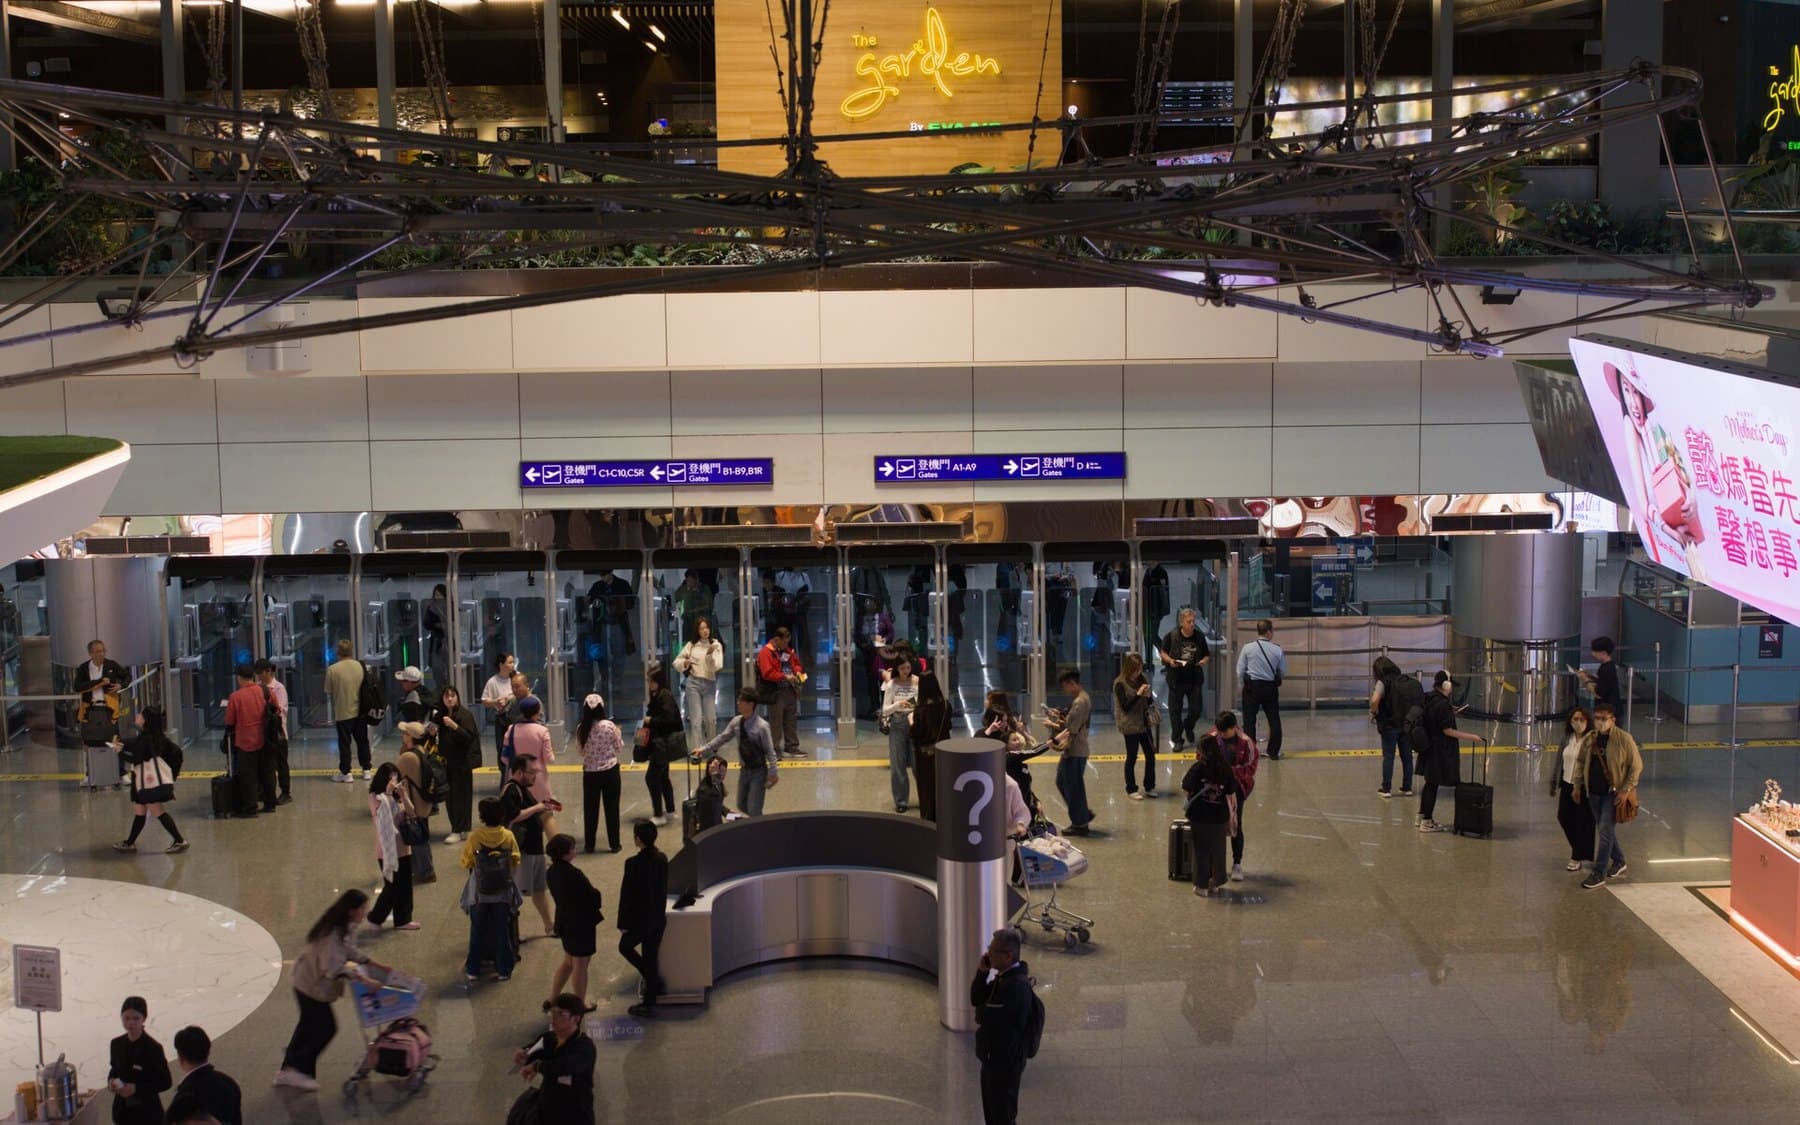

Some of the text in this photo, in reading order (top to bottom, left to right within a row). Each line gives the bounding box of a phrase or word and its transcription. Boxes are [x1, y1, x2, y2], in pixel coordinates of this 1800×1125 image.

[852, 34, 877, 47] The
[841, 8, 1000, 117] garden
[1762, 423, 1787, 456] Day
[688, 462, 763, 476] 登機門 B1-B9,B1R
[917, 459, 977, 472] 登機門 A1-A9
[1041, 457, 1075, 469] 登機門
[1076, 462, 1084, 470] D
[564, 464, 645, 478] 登機門 C1-C10,C5R
[917, 471, 938, 479] Gates
[1041, 469, 1063, 477] Gates
[564, 476, 585, 484] Gates
[688, 475, 709, 483] Gates
[1714, 504, 1800, 578] 馨想事
[953, 770, 994, 845] ?
